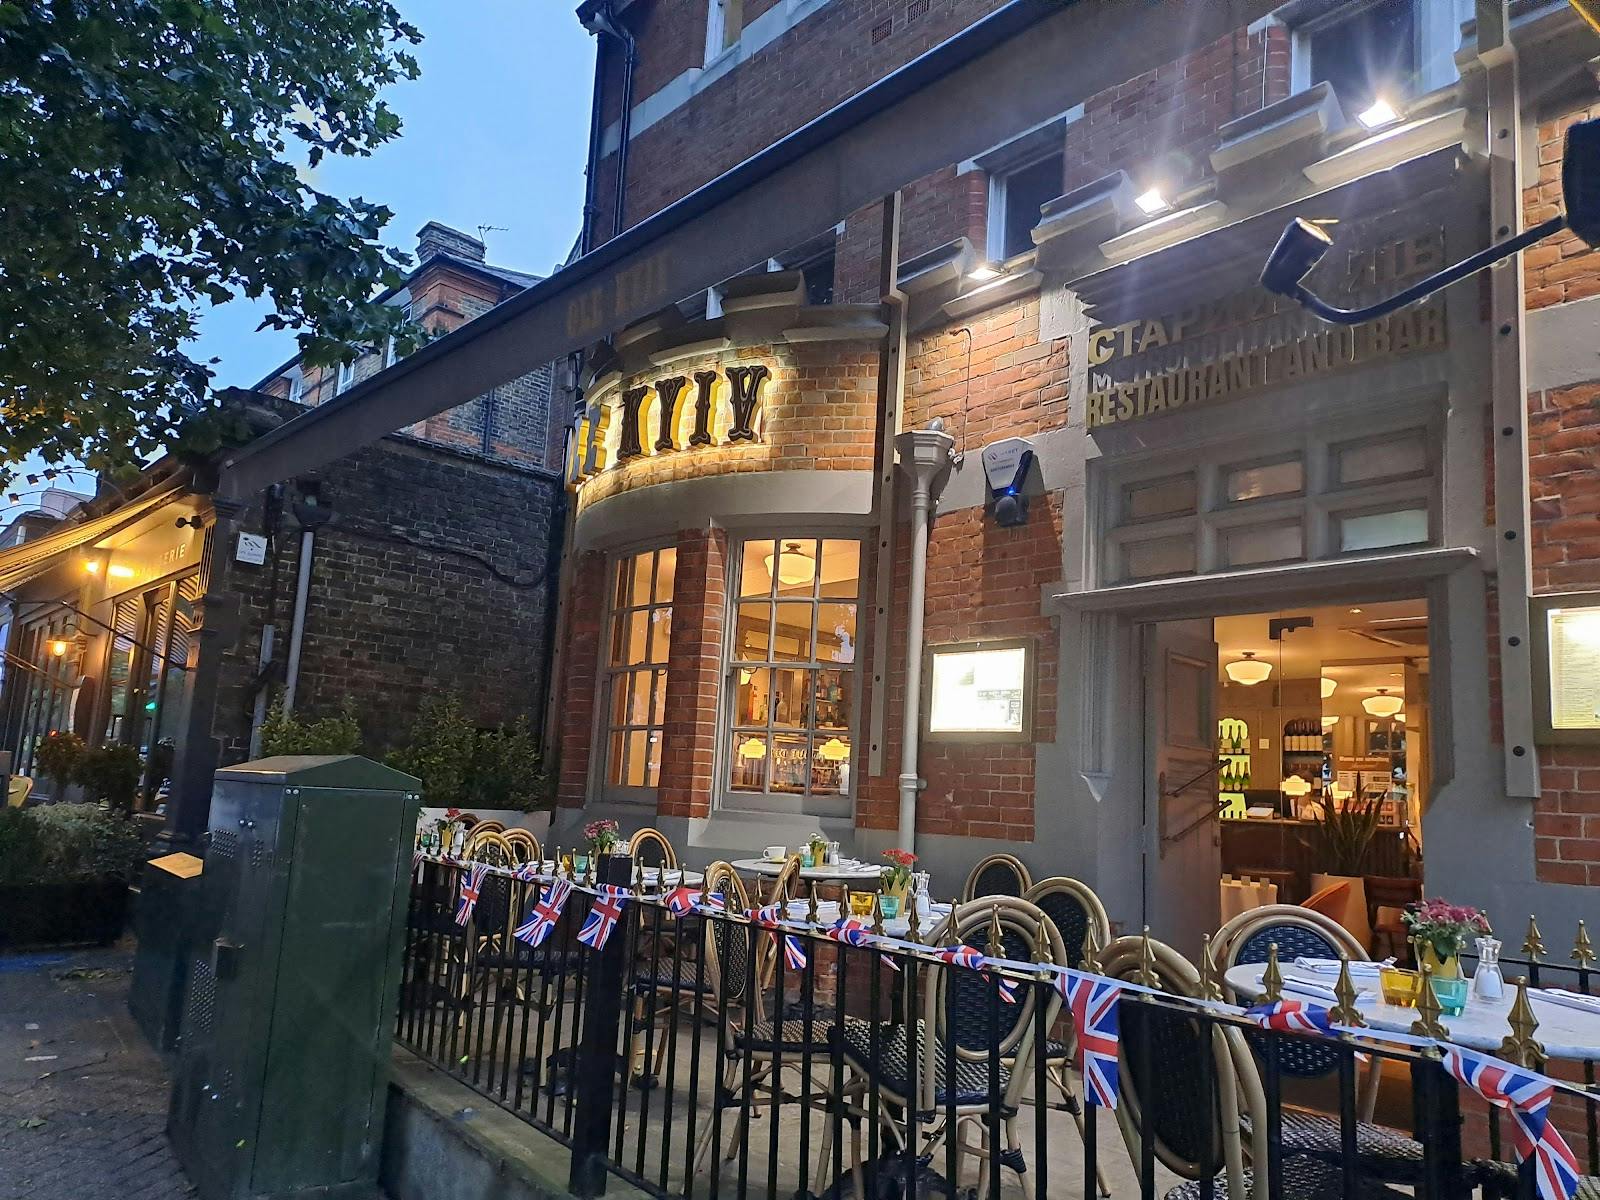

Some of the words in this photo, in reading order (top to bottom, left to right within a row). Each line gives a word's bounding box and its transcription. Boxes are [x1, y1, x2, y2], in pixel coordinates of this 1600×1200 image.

[1085, 343, 1272, 429] RESTAURANT
[1277, 324, 1356, 383] AND
[1370, 302, 1445, 360] BAR
